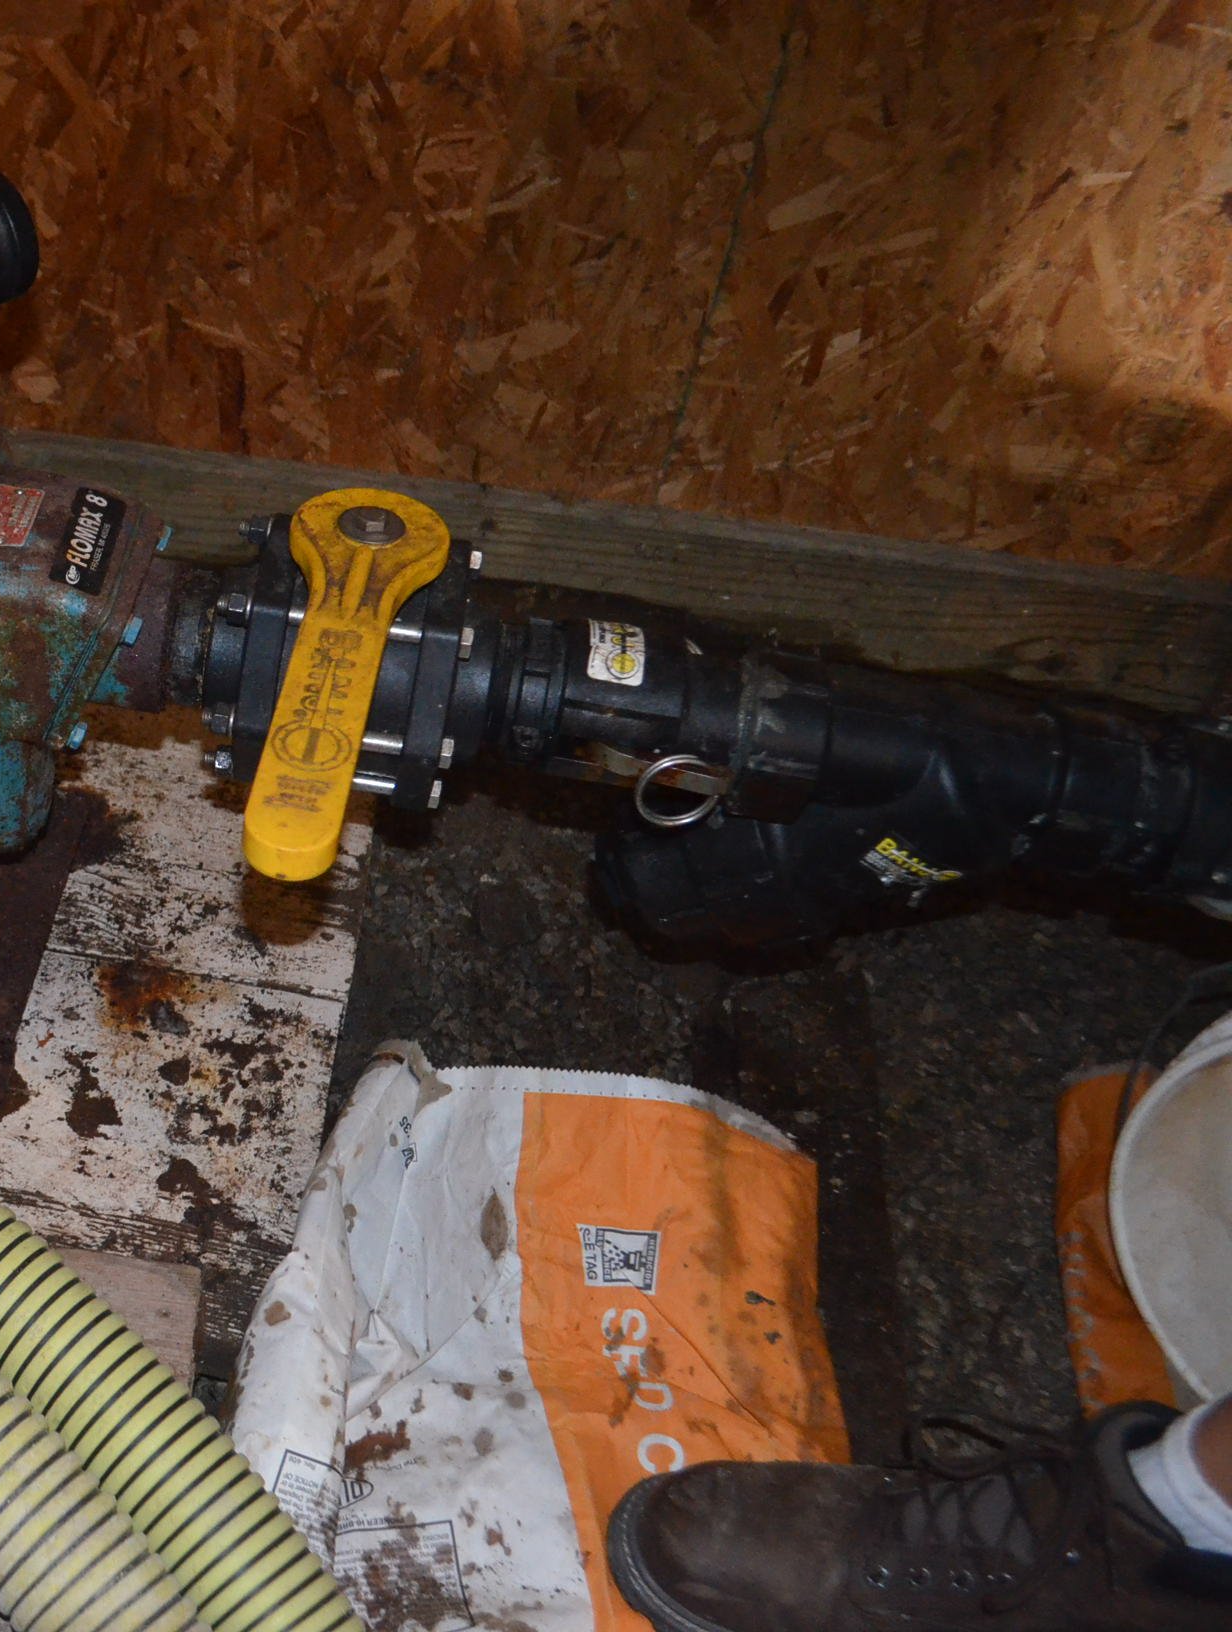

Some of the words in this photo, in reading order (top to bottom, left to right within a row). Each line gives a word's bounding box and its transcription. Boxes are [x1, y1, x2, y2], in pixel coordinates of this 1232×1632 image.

[66, 506, 103, 568] FLOMAX
[85, 493, 108, 508] 8
[585, 1254, 597, 1280] TAG
[644, 1234, 656, 1286] HERBICIDE
